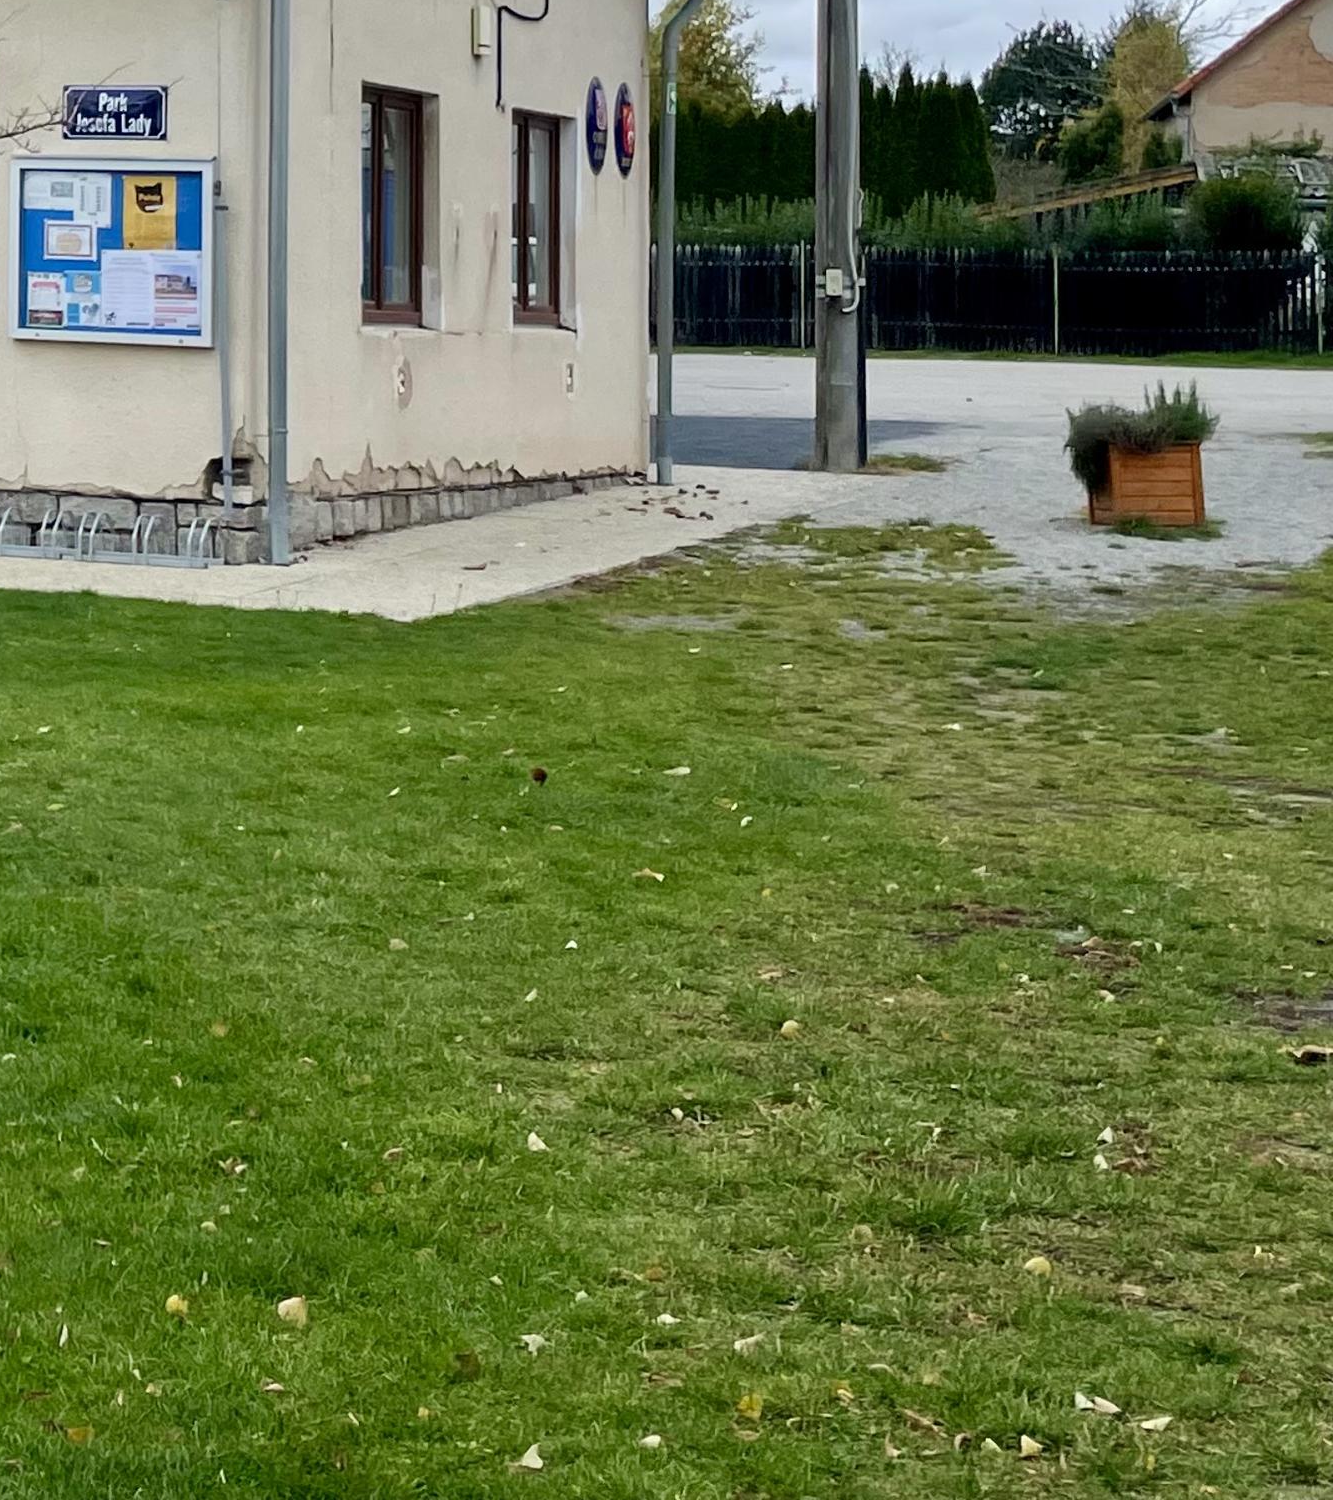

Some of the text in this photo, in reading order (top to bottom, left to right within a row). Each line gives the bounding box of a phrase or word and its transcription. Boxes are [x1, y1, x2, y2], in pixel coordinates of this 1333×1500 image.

[98, 92, 128, 112] Park
[75, 112, 152, 137] Josefa Lady
